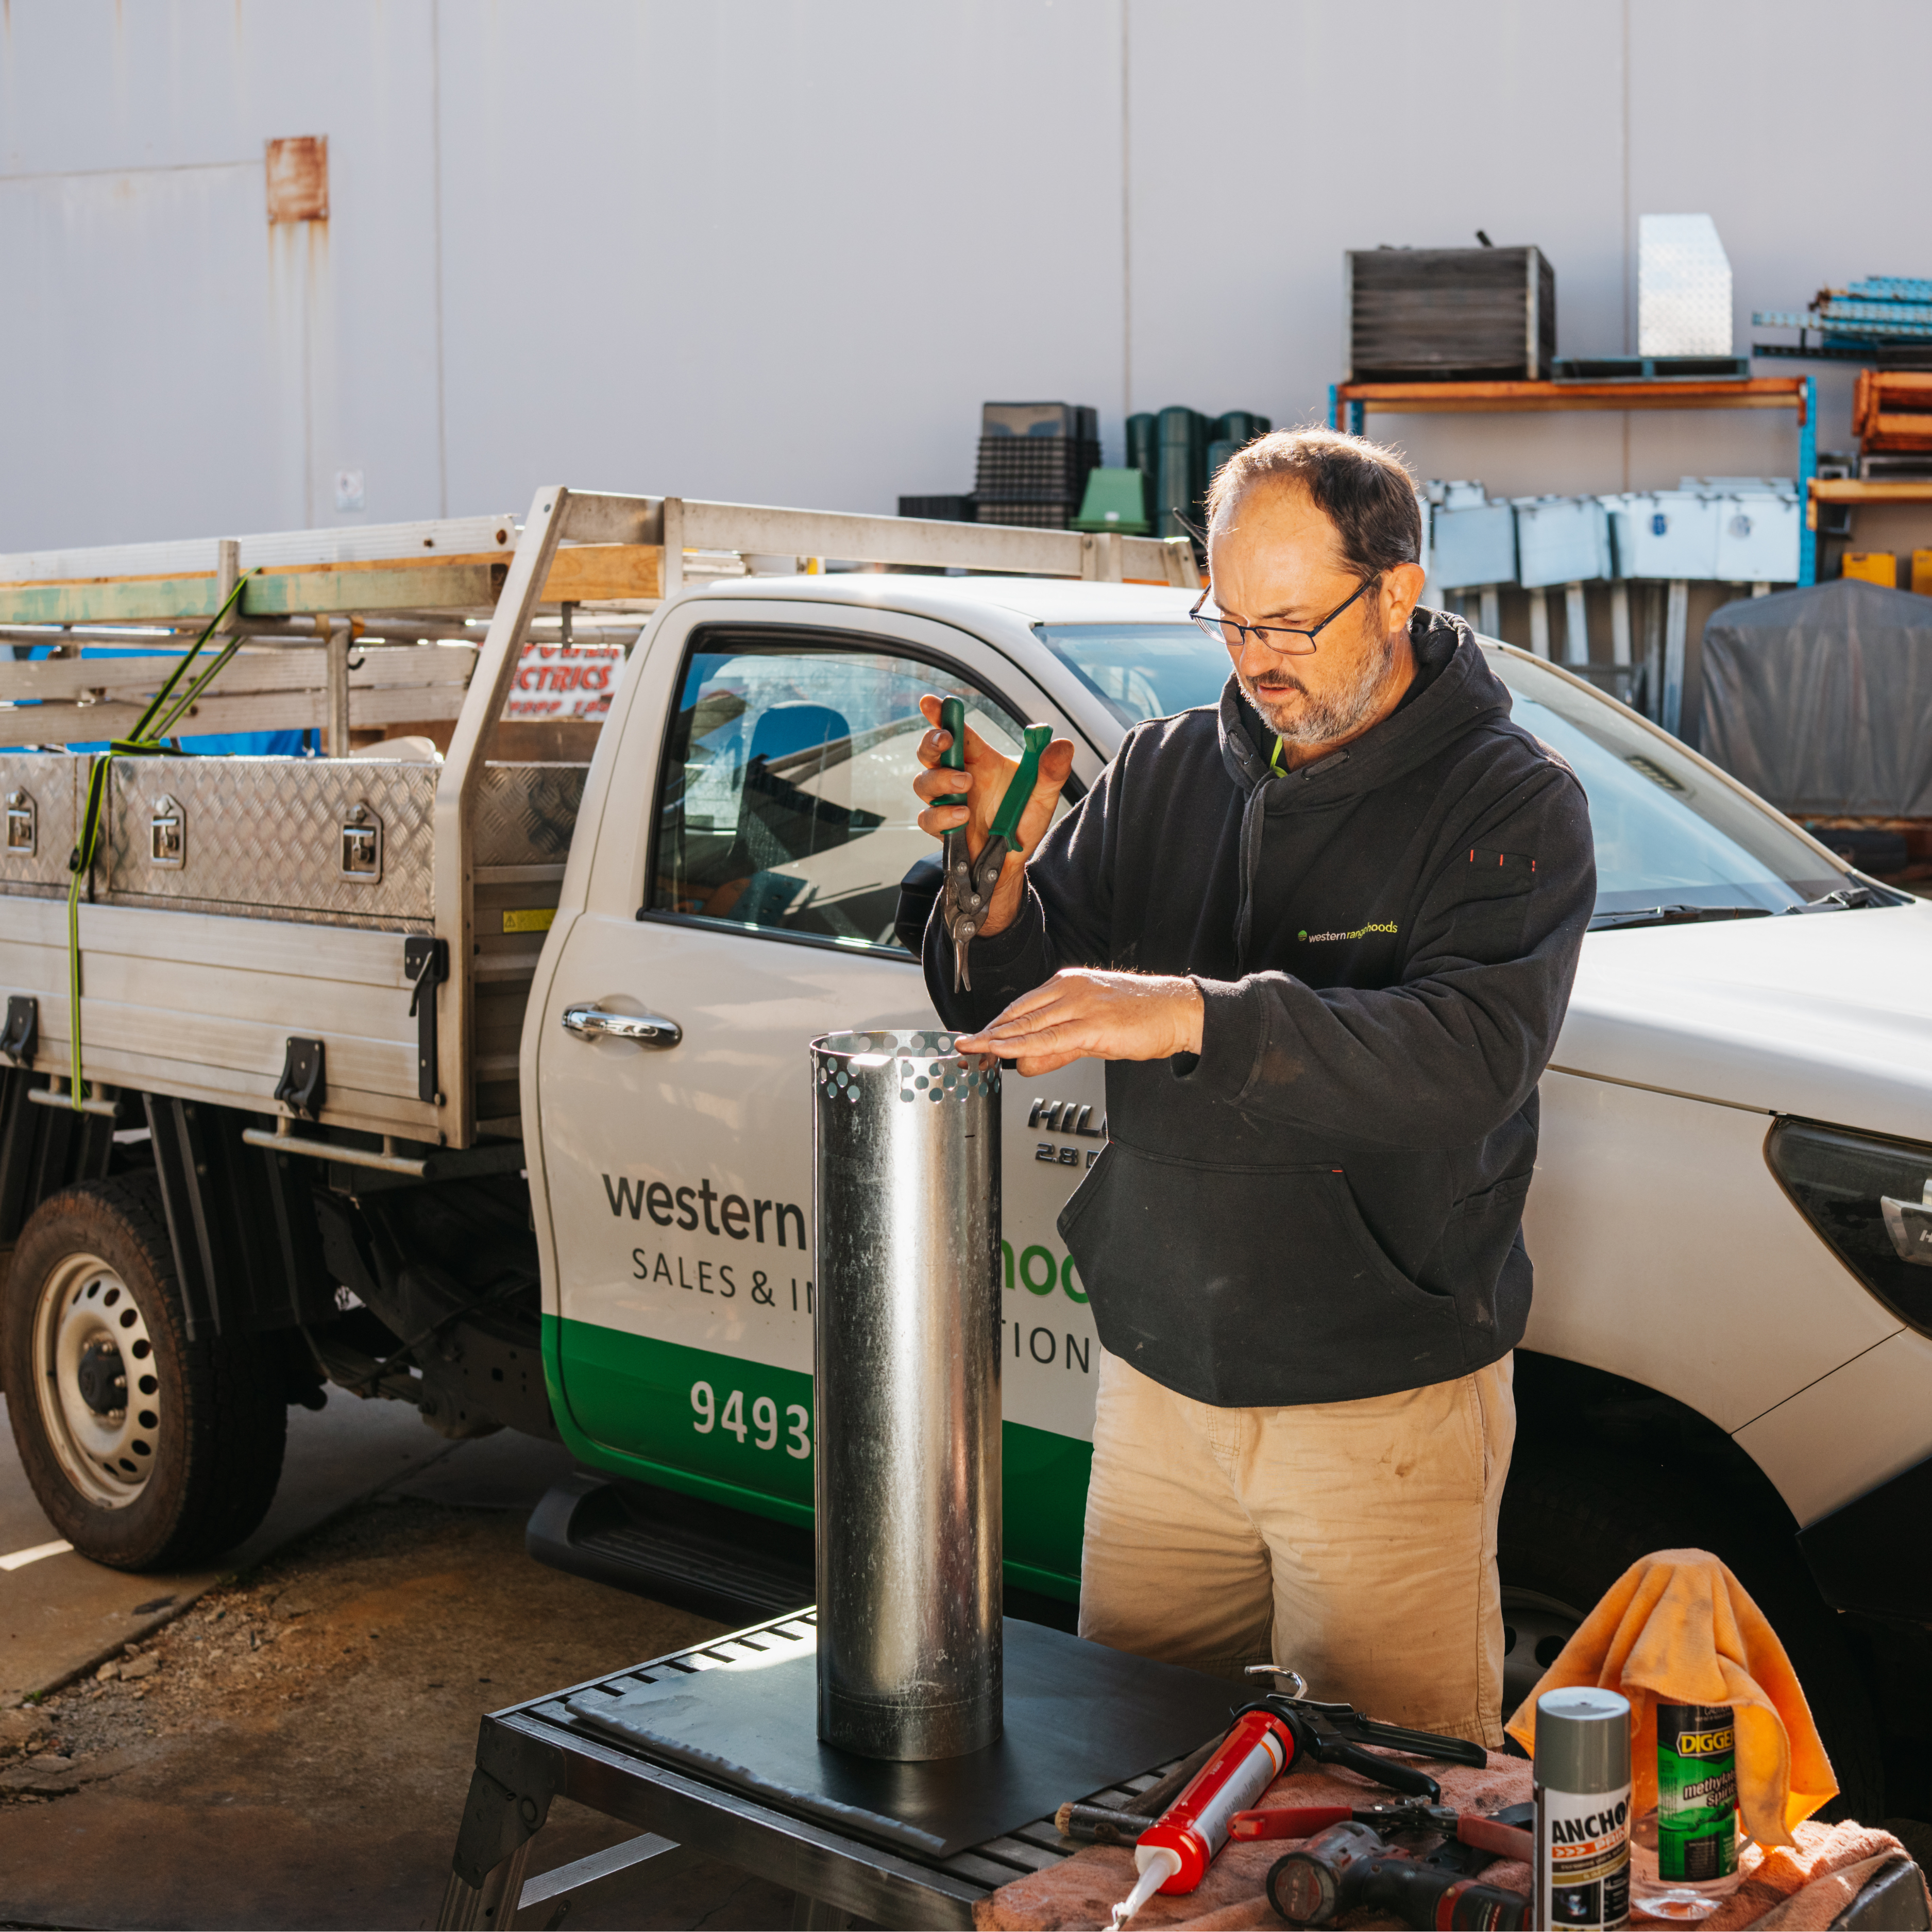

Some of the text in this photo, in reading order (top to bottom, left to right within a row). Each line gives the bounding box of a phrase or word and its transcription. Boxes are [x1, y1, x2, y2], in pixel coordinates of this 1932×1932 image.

[1028, 1097, 1108, 1138] HIL
[1035, 1142, 1080, 1167] 2.8
[601, 1173, 807, 1251] western
[632, 1247, 736, 1298] SALES
[751, 1270, 776, 1307] &
[1001, 1318, 1090, 1374] ION
[690, 1380, 811, 1460] 9493
